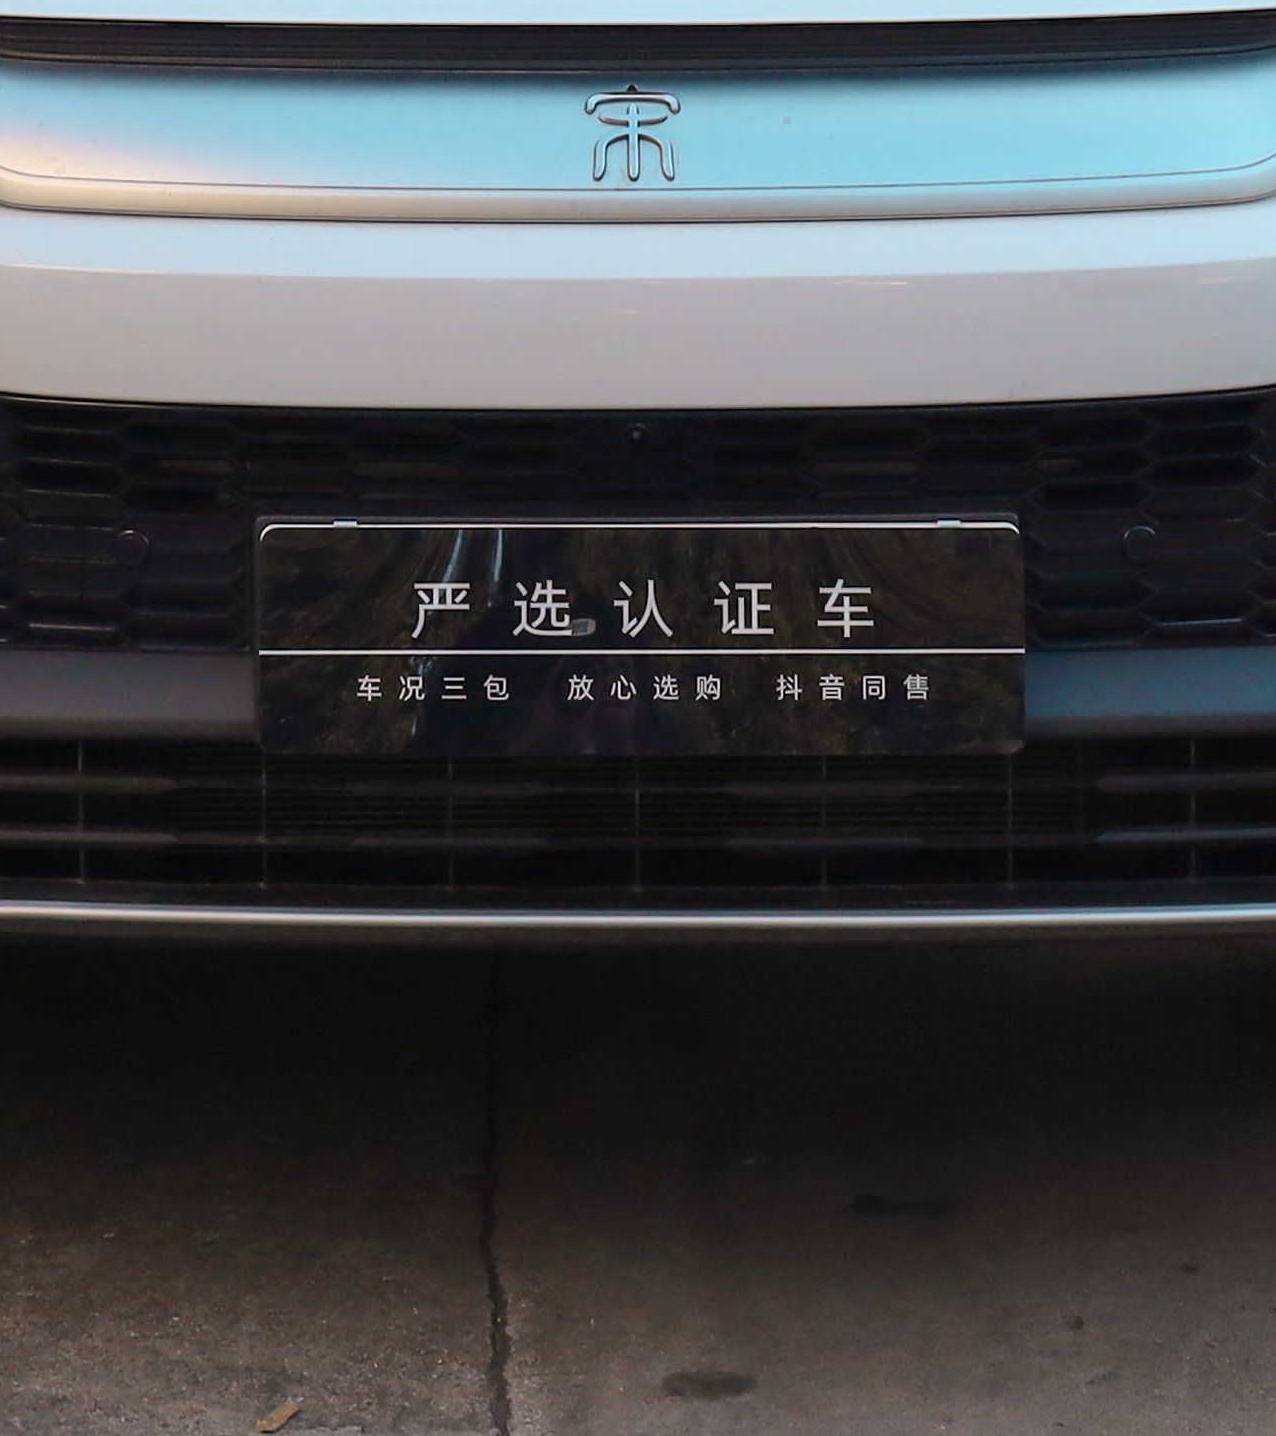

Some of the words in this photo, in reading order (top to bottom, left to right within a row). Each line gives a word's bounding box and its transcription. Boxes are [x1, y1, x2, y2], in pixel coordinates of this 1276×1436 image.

[411, 579, 875, 640] 严选认证车
[356, 674, 511, 703] 车况三包
[567, 674, 723, 703] 放心选购
[776, 673, 931, 703] 抖音同售
